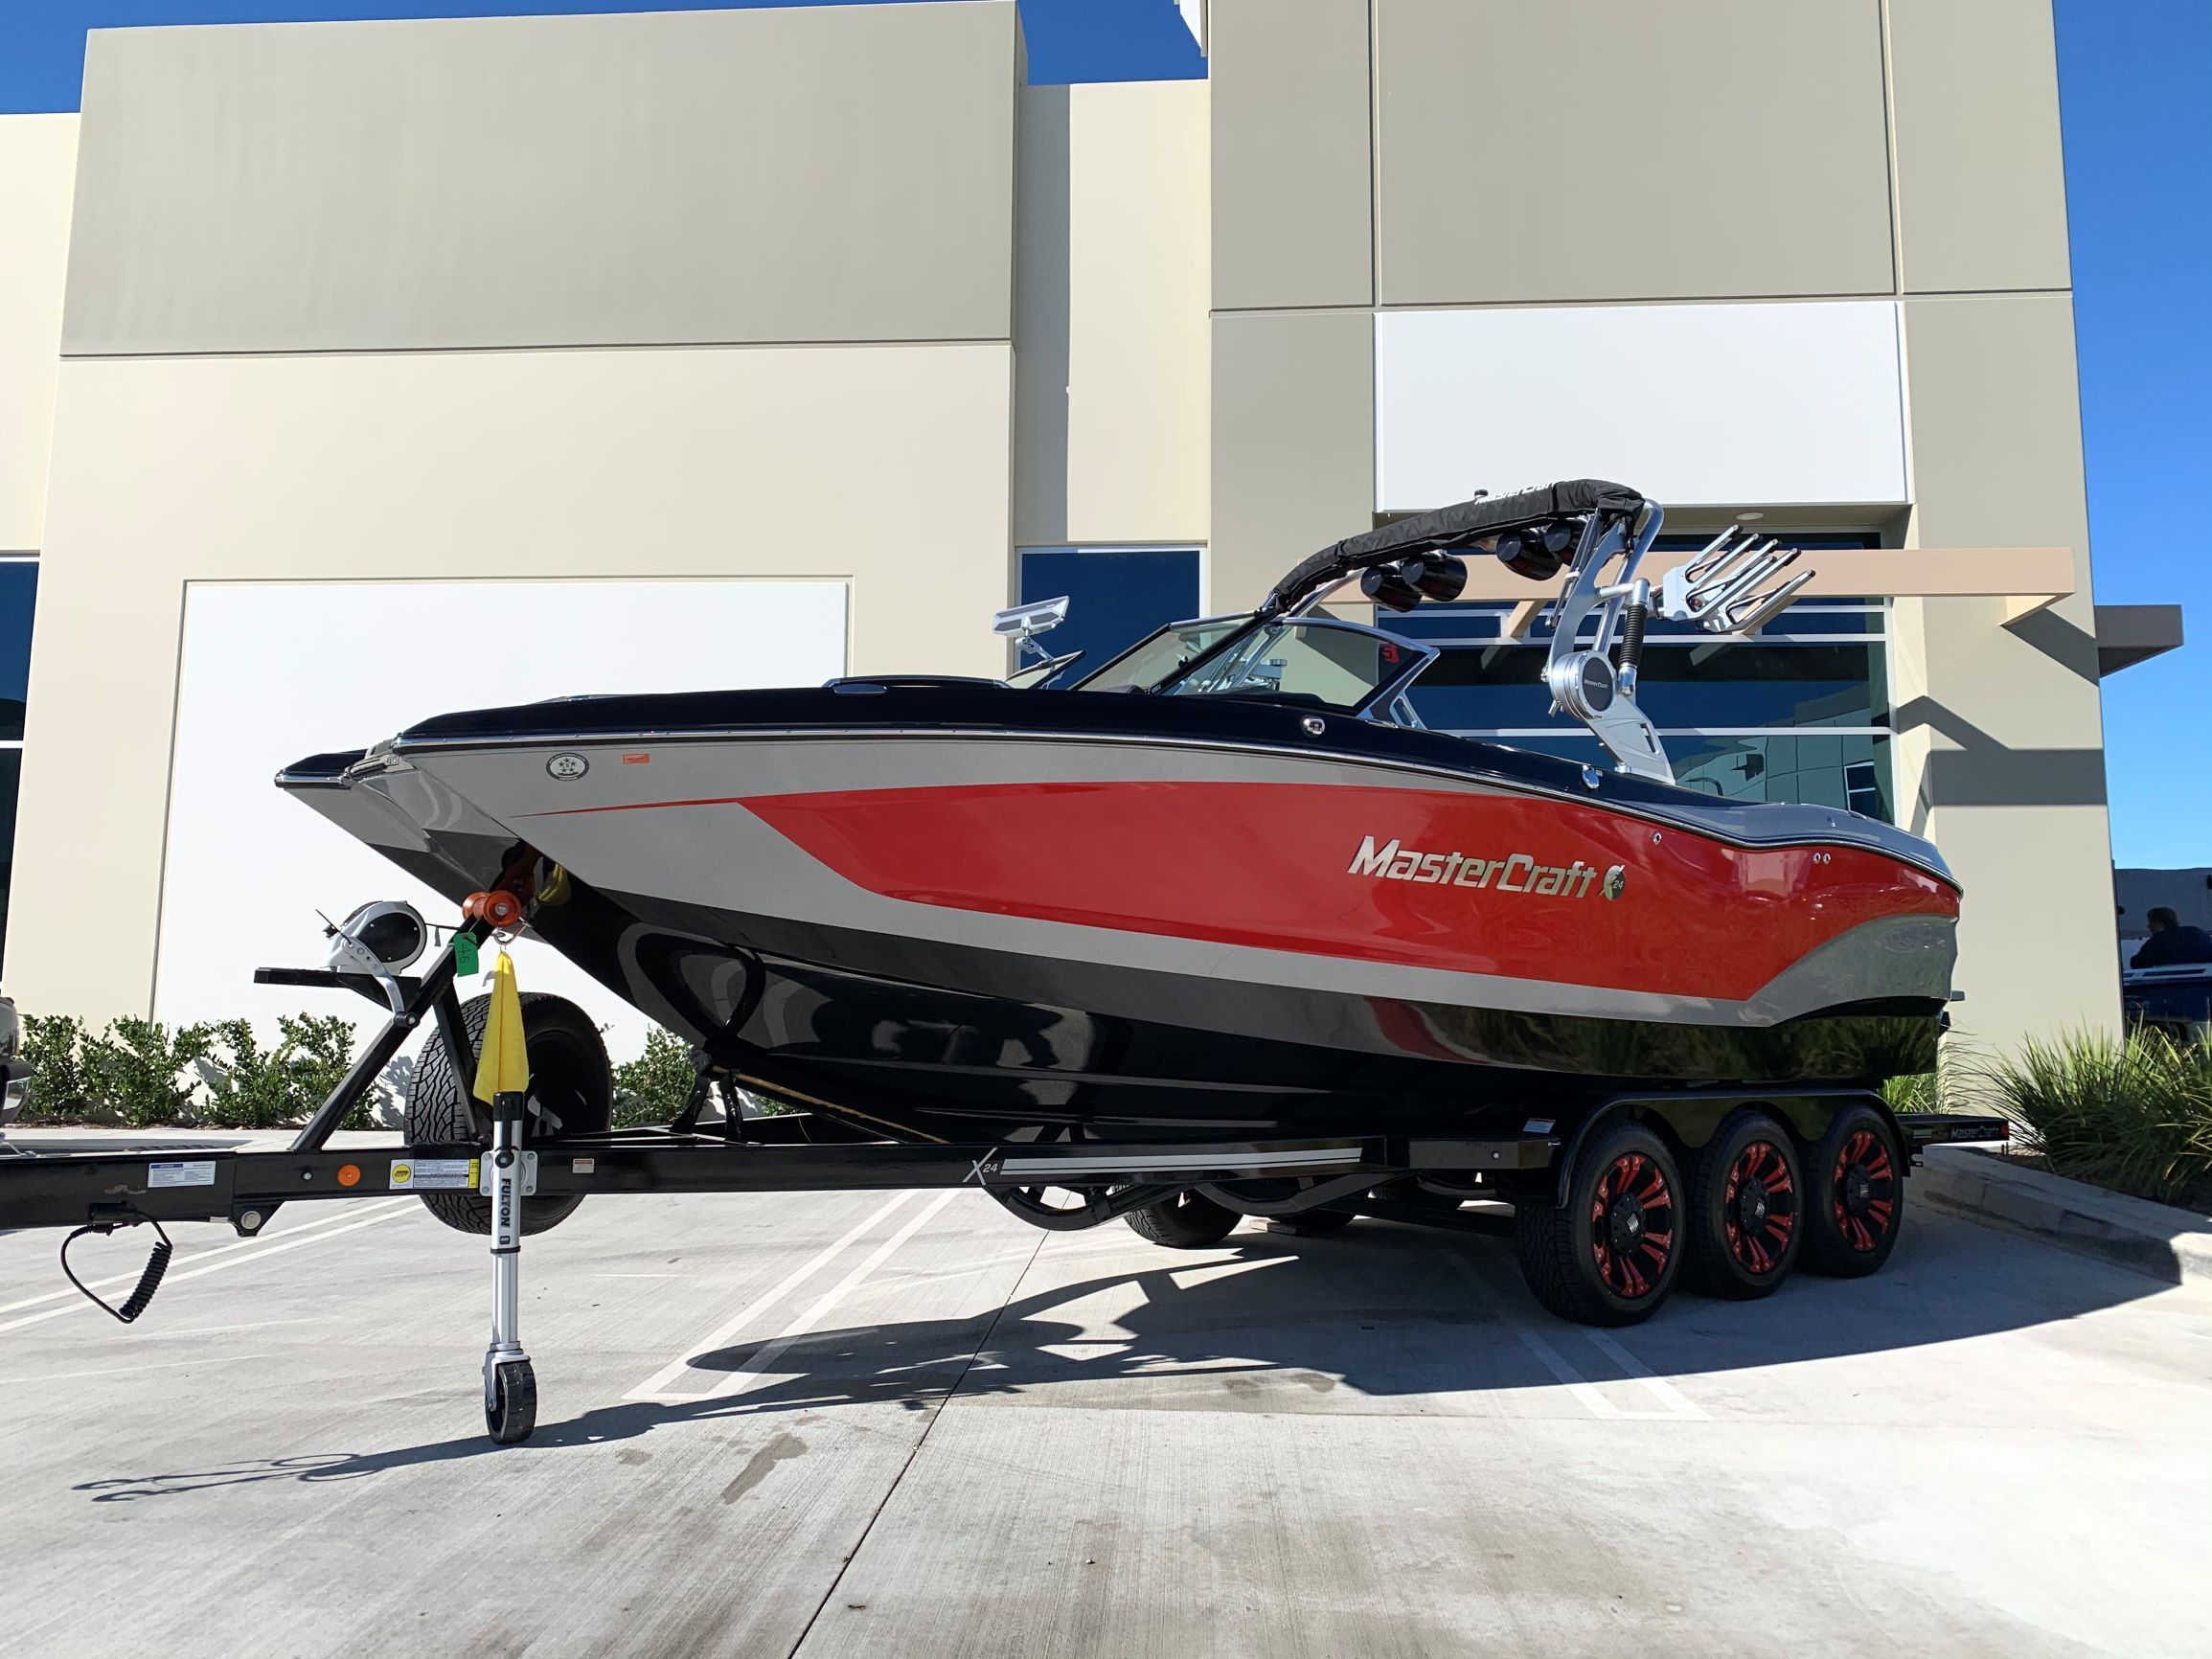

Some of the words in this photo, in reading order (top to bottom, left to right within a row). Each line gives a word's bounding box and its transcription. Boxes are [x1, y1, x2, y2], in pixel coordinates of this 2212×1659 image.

[1347, 835, 1597, 898] MasterCraft
[1612, 879, 1625, 890] 24
[500, 1177, 513, 1228] FULTON
